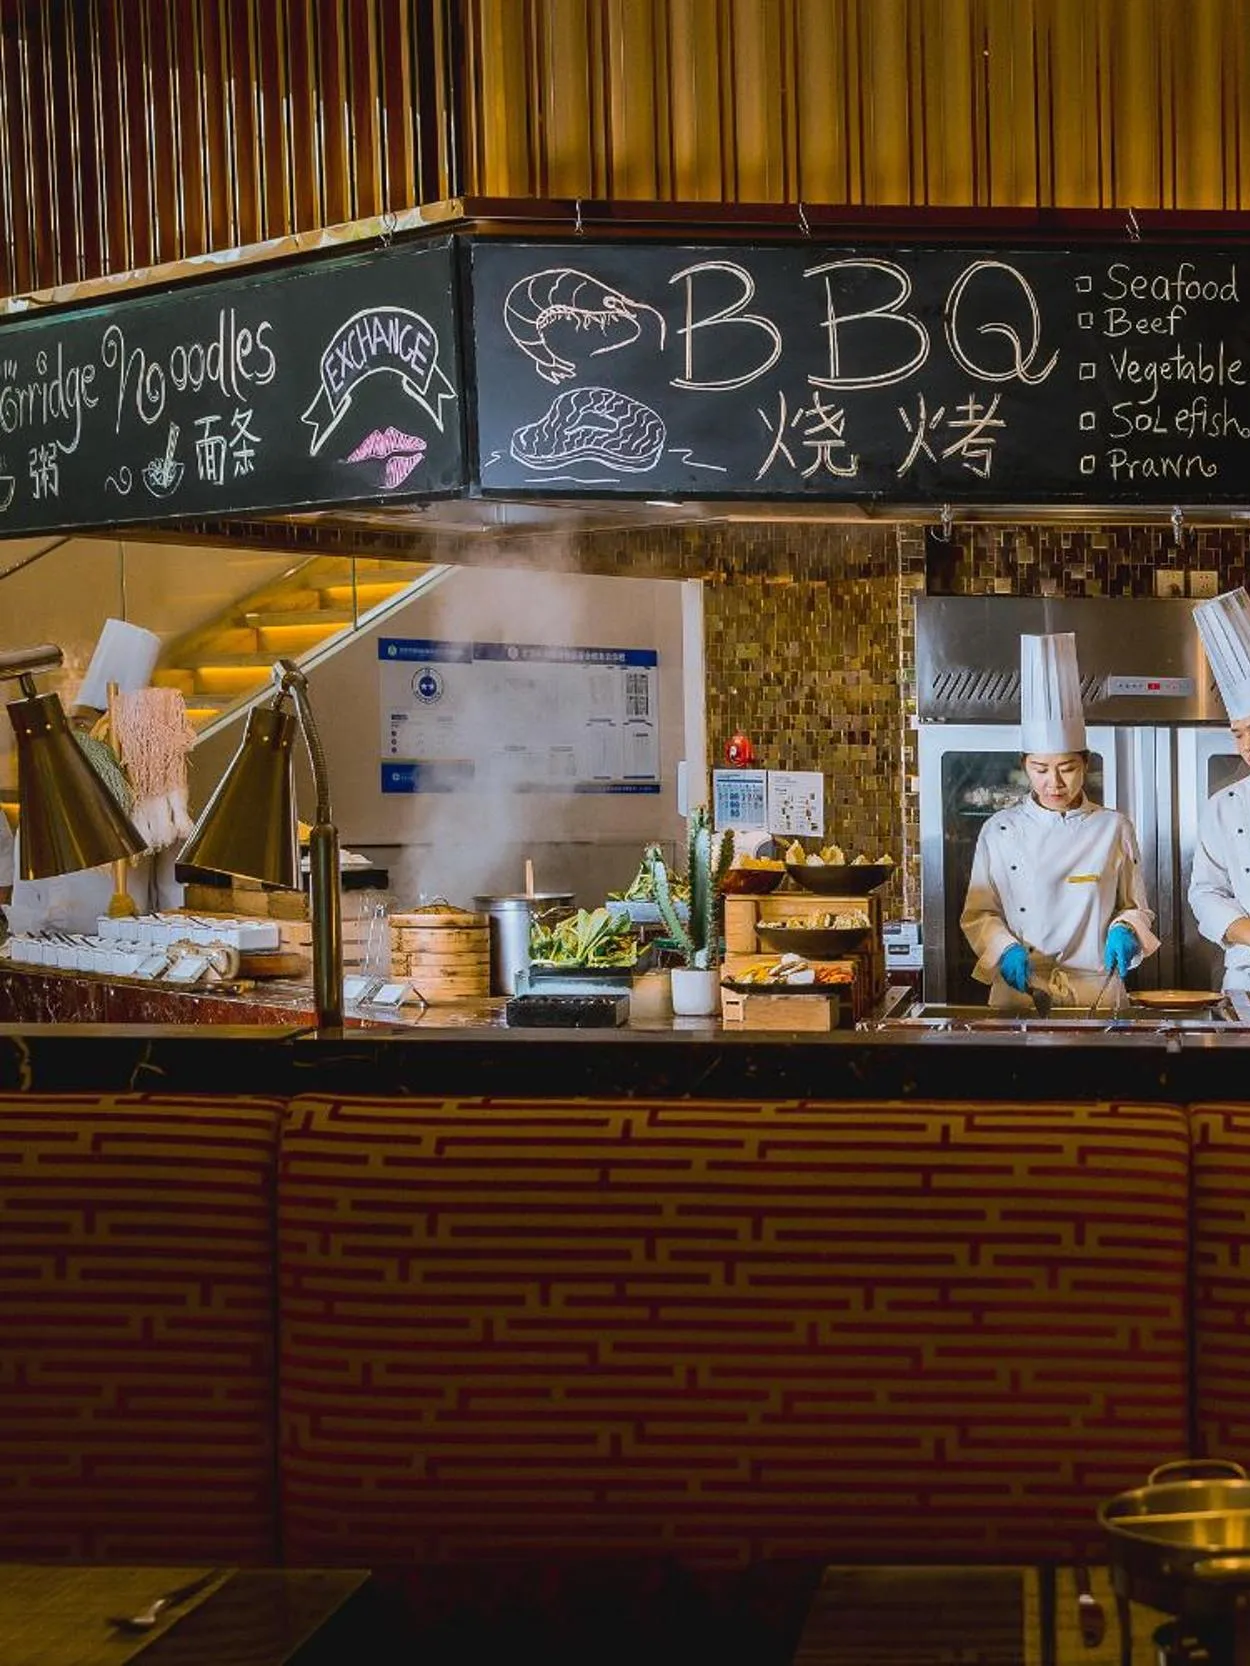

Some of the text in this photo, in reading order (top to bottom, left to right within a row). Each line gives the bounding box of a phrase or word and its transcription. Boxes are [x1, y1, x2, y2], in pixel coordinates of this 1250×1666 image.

[1102, 262, 1240, 303] Seafood
[668, 257, 1060, 392] BBQ
[1102, 304, 1188, 337] Beef
[324, 315, 431, 394] EXCHANGE
[1109, 341, 1247, 405] Vegetable
[193, 407, 262, 486] 面条
[754, 390, 1007, 481] 烧烤
[1105, 448, 1218, 481] Prawn
[28, 441, 60, 500] 粥
